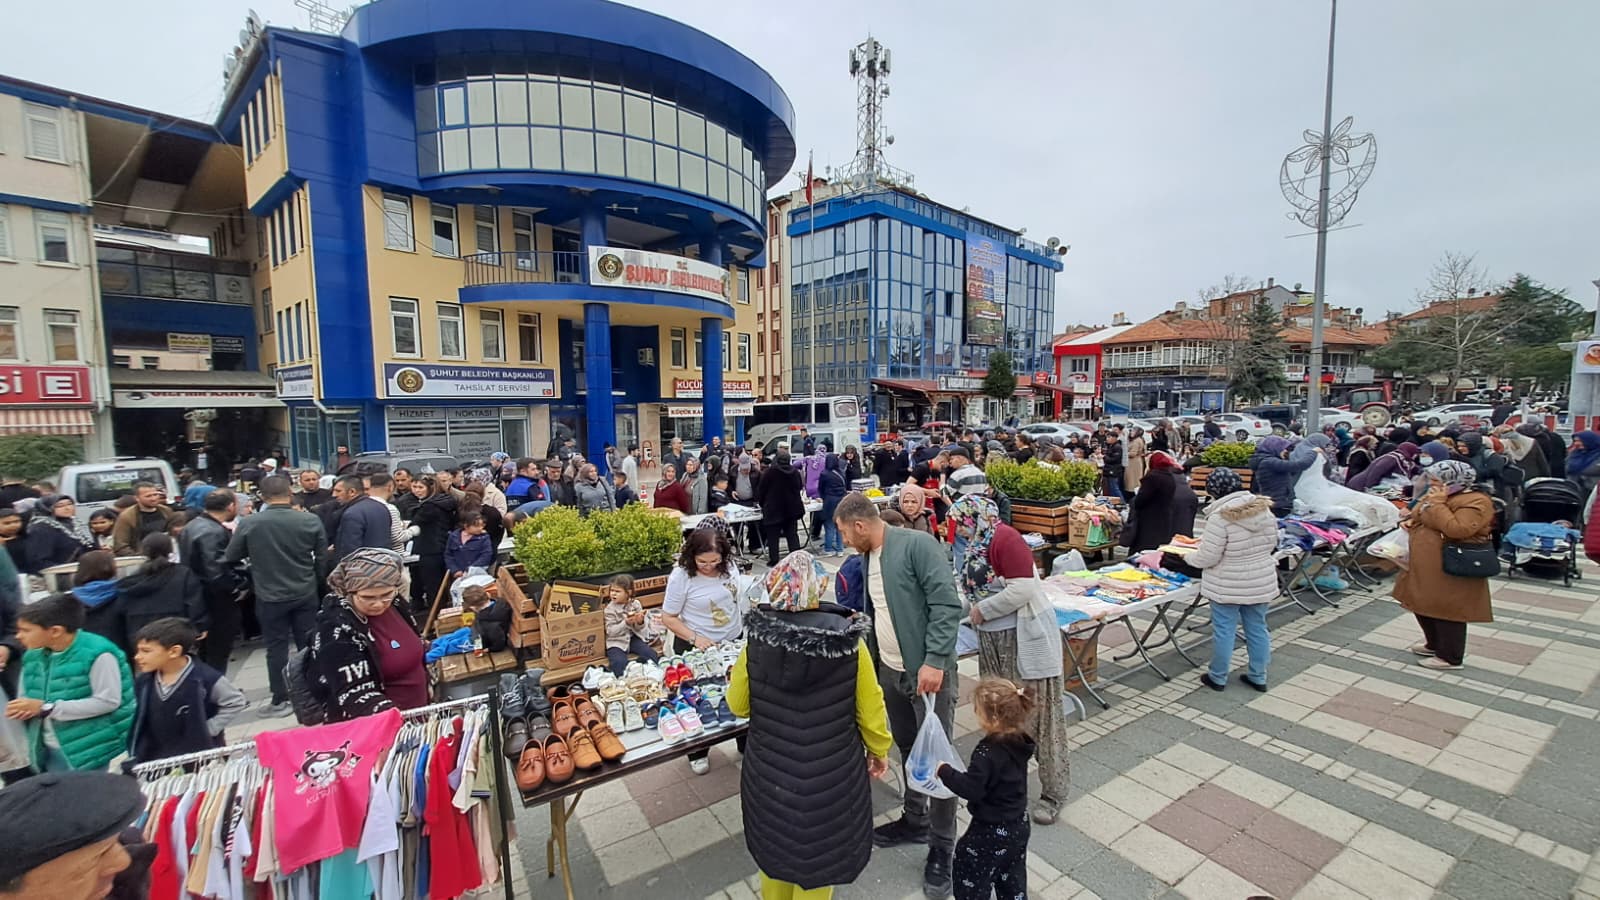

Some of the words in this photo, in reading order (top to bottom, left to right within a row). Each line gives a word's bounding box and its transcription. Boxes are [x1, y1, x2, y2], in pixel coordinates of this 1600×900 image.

[430, 369, 459, 378] ŞUHUT
[461, 369, 500, 379] BELEDİYE
[502, 370, 546, 380] BAŞKANLIĞI
[455, 383, 496, 391] TAHSİLAT
[498, 384, 530, 392] SERVİSİ
[399, 409, 434, 417] HİZMET
[455, 409, 492, 417] NOKTASI
